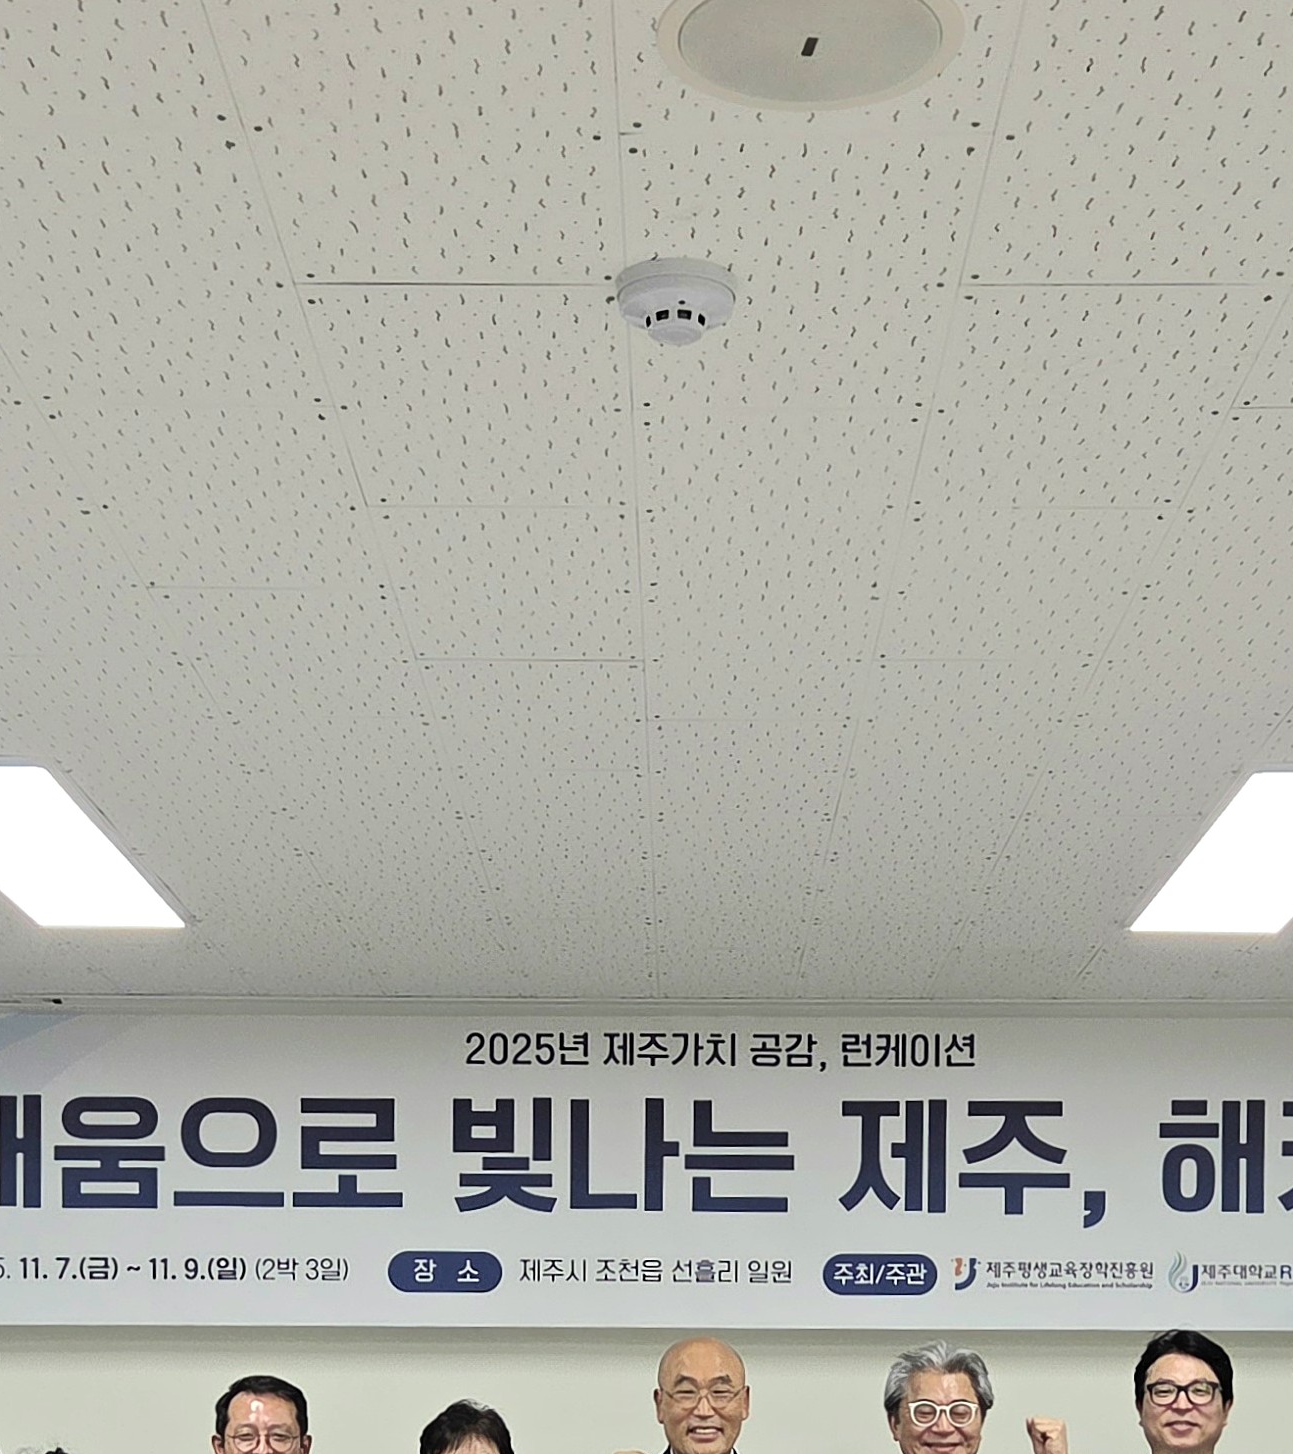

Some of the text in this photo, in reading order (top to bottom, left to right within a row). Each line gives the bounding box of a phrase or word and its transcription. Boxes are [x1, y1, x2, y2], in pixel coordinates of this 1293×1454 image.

[466, 1032, 975, 1072] 2025년 제주가치 공감, 런케이션
[453, 1097, 794, 1212] 빛나는
[839, 1099, 1106, 1228] 제주,
[256, 1258, 299, 1280] (2박
[306, 1258, 348, 1281] 3일)
[520, 1259, 586, 1282] 제주시
[596, 1259, 662, 1282] 조천읍
[672, 1260, 738, 1283] 선흘리
[748, 1261, 791, 1283] 일원
[834, 1263, 927, 1285] 주최/주관
[987, 1261, 1153, 1279] 제주평생교육장학진흥원
